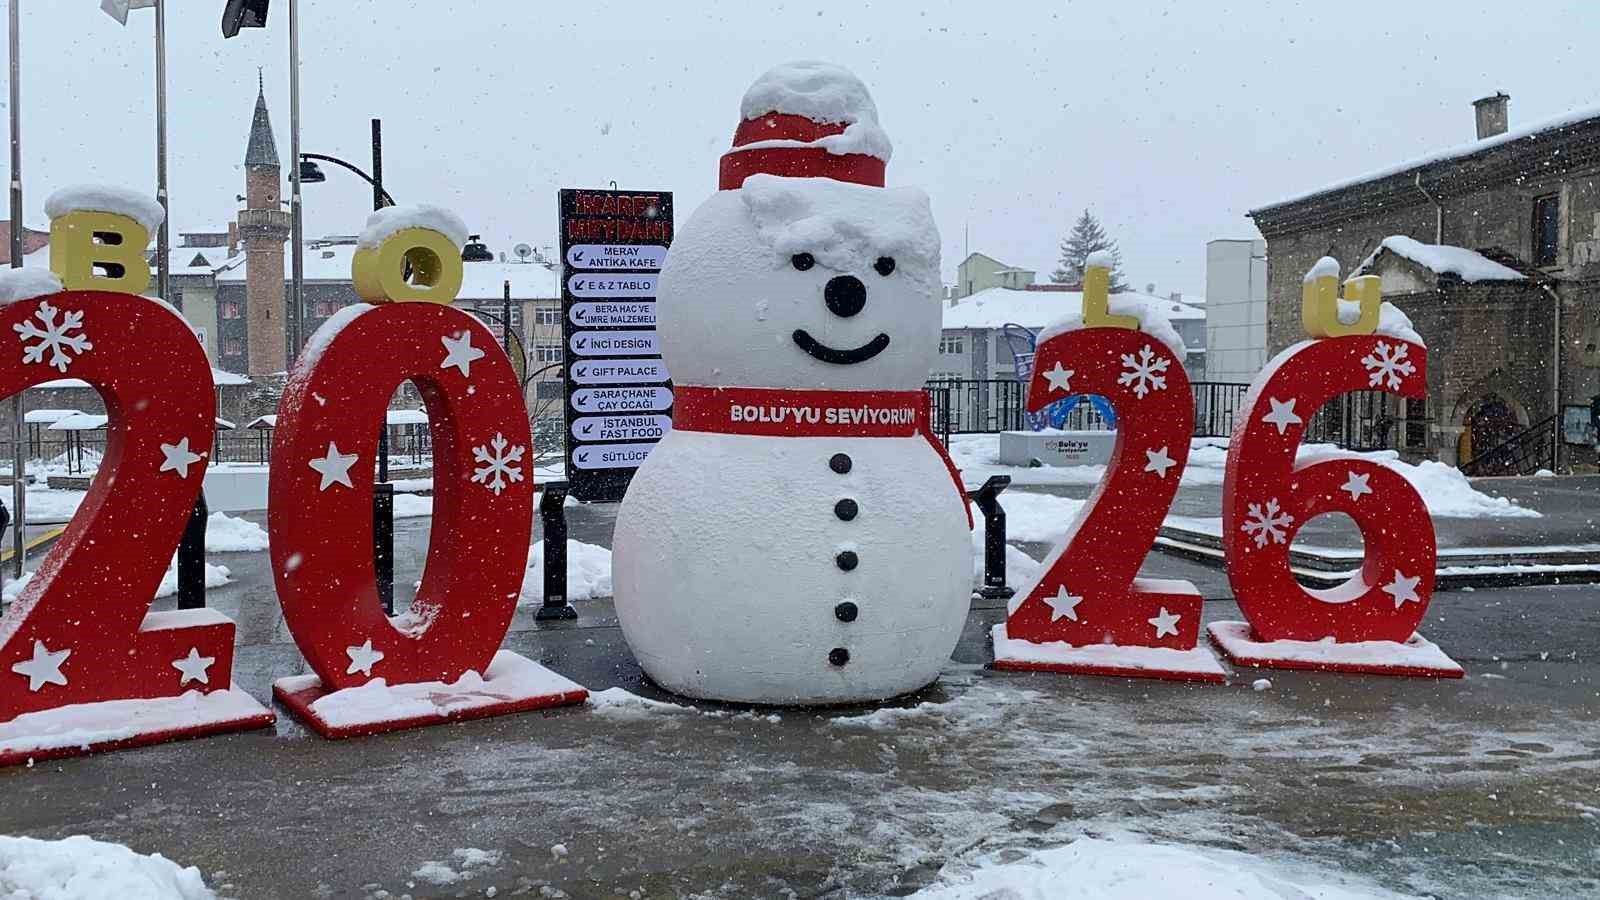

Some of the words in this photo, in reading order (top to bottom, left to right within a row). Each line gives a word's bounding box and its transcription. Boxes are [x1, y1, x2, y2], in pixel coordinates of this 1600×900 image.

[604, 247, 640, 256] MERAY
[589, 257, 627, 267] ANTİKA
[629, 258, 657, 267] KAFE
[588, 281, 595, 290] E
[598, 281, 606, 290] &
[608, 281, 615, 290] Z
[617, 281, 651, 290] TABLO
[595, 304, 618, 313] BERA
[619, 304, 637, 313] HAC
[639, 304, 650, 313] VE
[592, 367, 615, 376] GIFT
[617, 367, 657, 376] PALACE
[593, 390, 657, 400] SARAÇHANE
[620, 399, 653, 409] OCAĞI
[730, 404, 821, 424] BOLU'YU
[603, 416, 659, 428] İSTANBUL
[600, 429, 628, 439] FAST
[632, 428, 663, 438] FOOD
